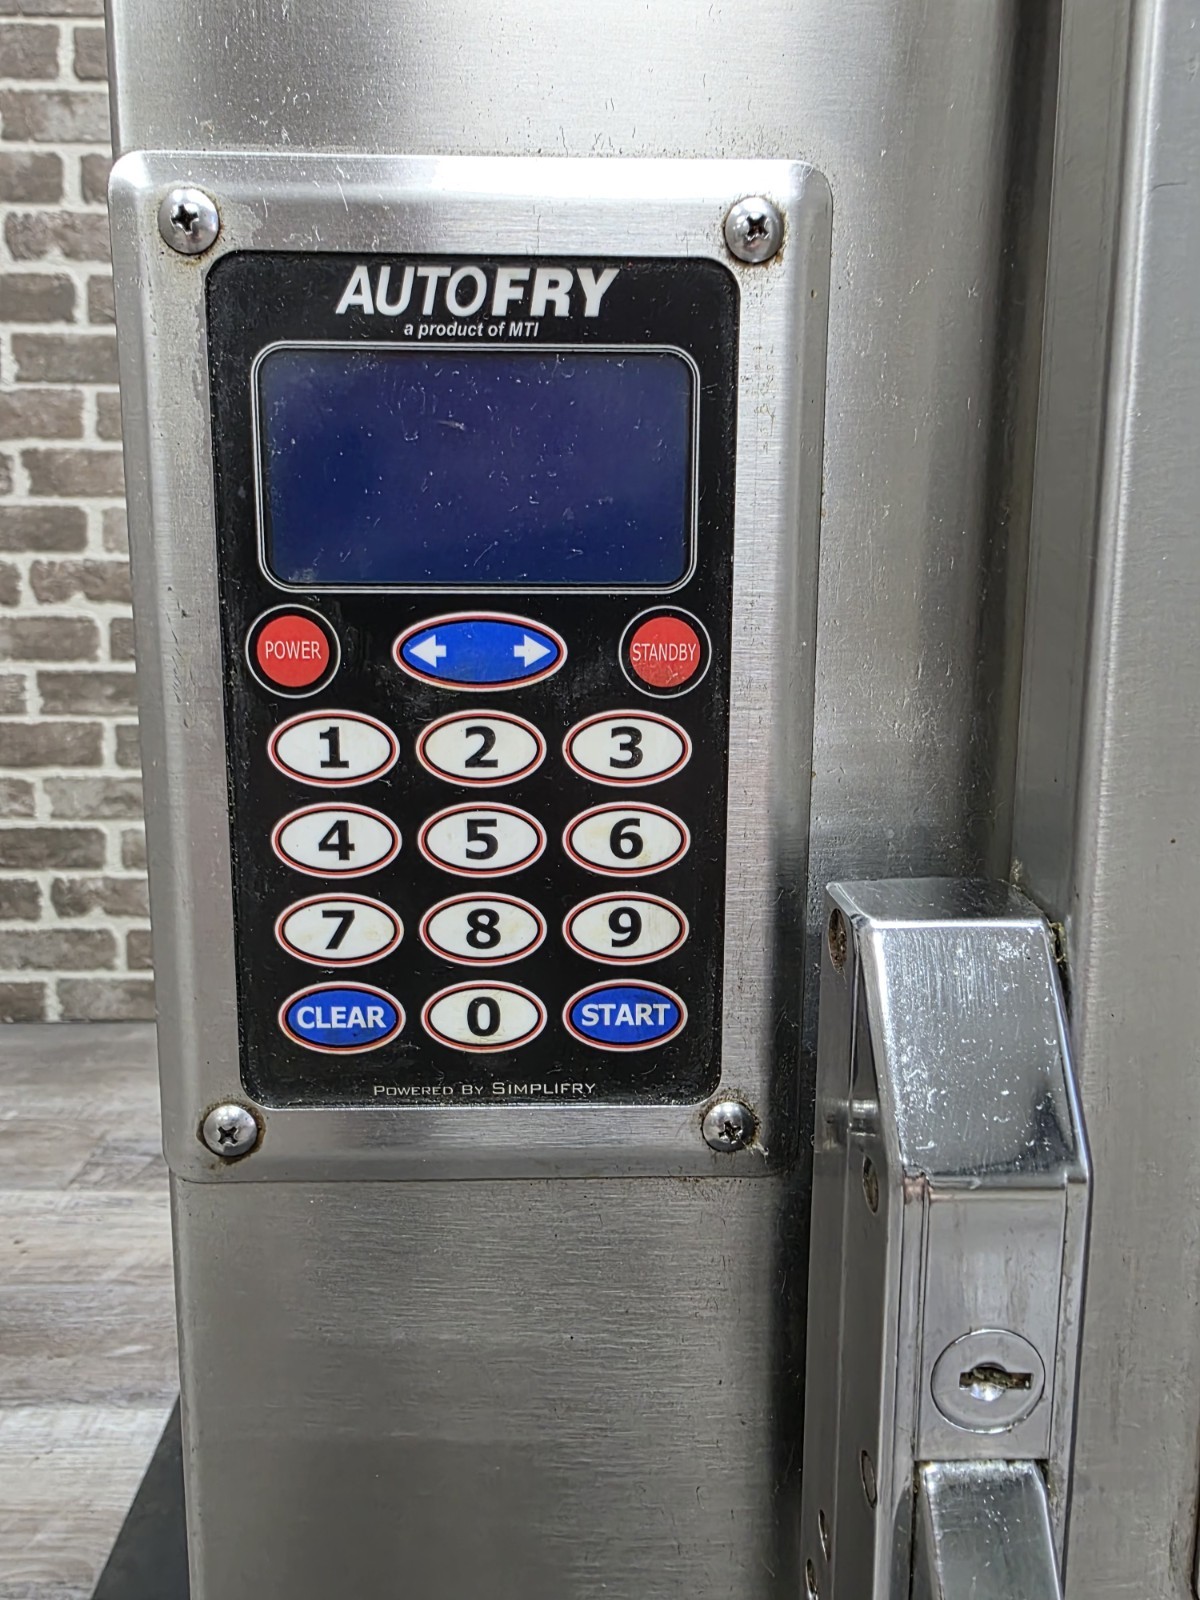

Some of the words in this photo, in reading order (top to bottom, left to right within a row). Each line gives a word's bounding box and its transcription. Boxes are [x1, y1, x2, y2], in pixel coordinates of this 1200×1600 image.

[336, 265, 619, 318] AUTOFRY
[404, 326, 414, 336] a
[418, 322, 484, 340] product
[487, 322, 505, 337] of
[509, 322, 539, 337] MTI
[265, 641, 321, 660] POWER
[632, 643, 697, 662] STANDBY
[319, 726, 350, 769] 1
[464, 726, 499, 769] 2
[609, 726, 644, 769] 3
[318, 819, 355, 860] 4
[465, 819, 499, 860] 5
[609, 818, 644, 860] 6
[321, 910, 355, 950] 7
[466, 908, 501, 949] 8
[608, 907, 642, 948] 9
[297, 1006, 386, 1029] CLEAR
[466, 997, 501, 1036] 0
[581, 1003, 671, 1027] START
